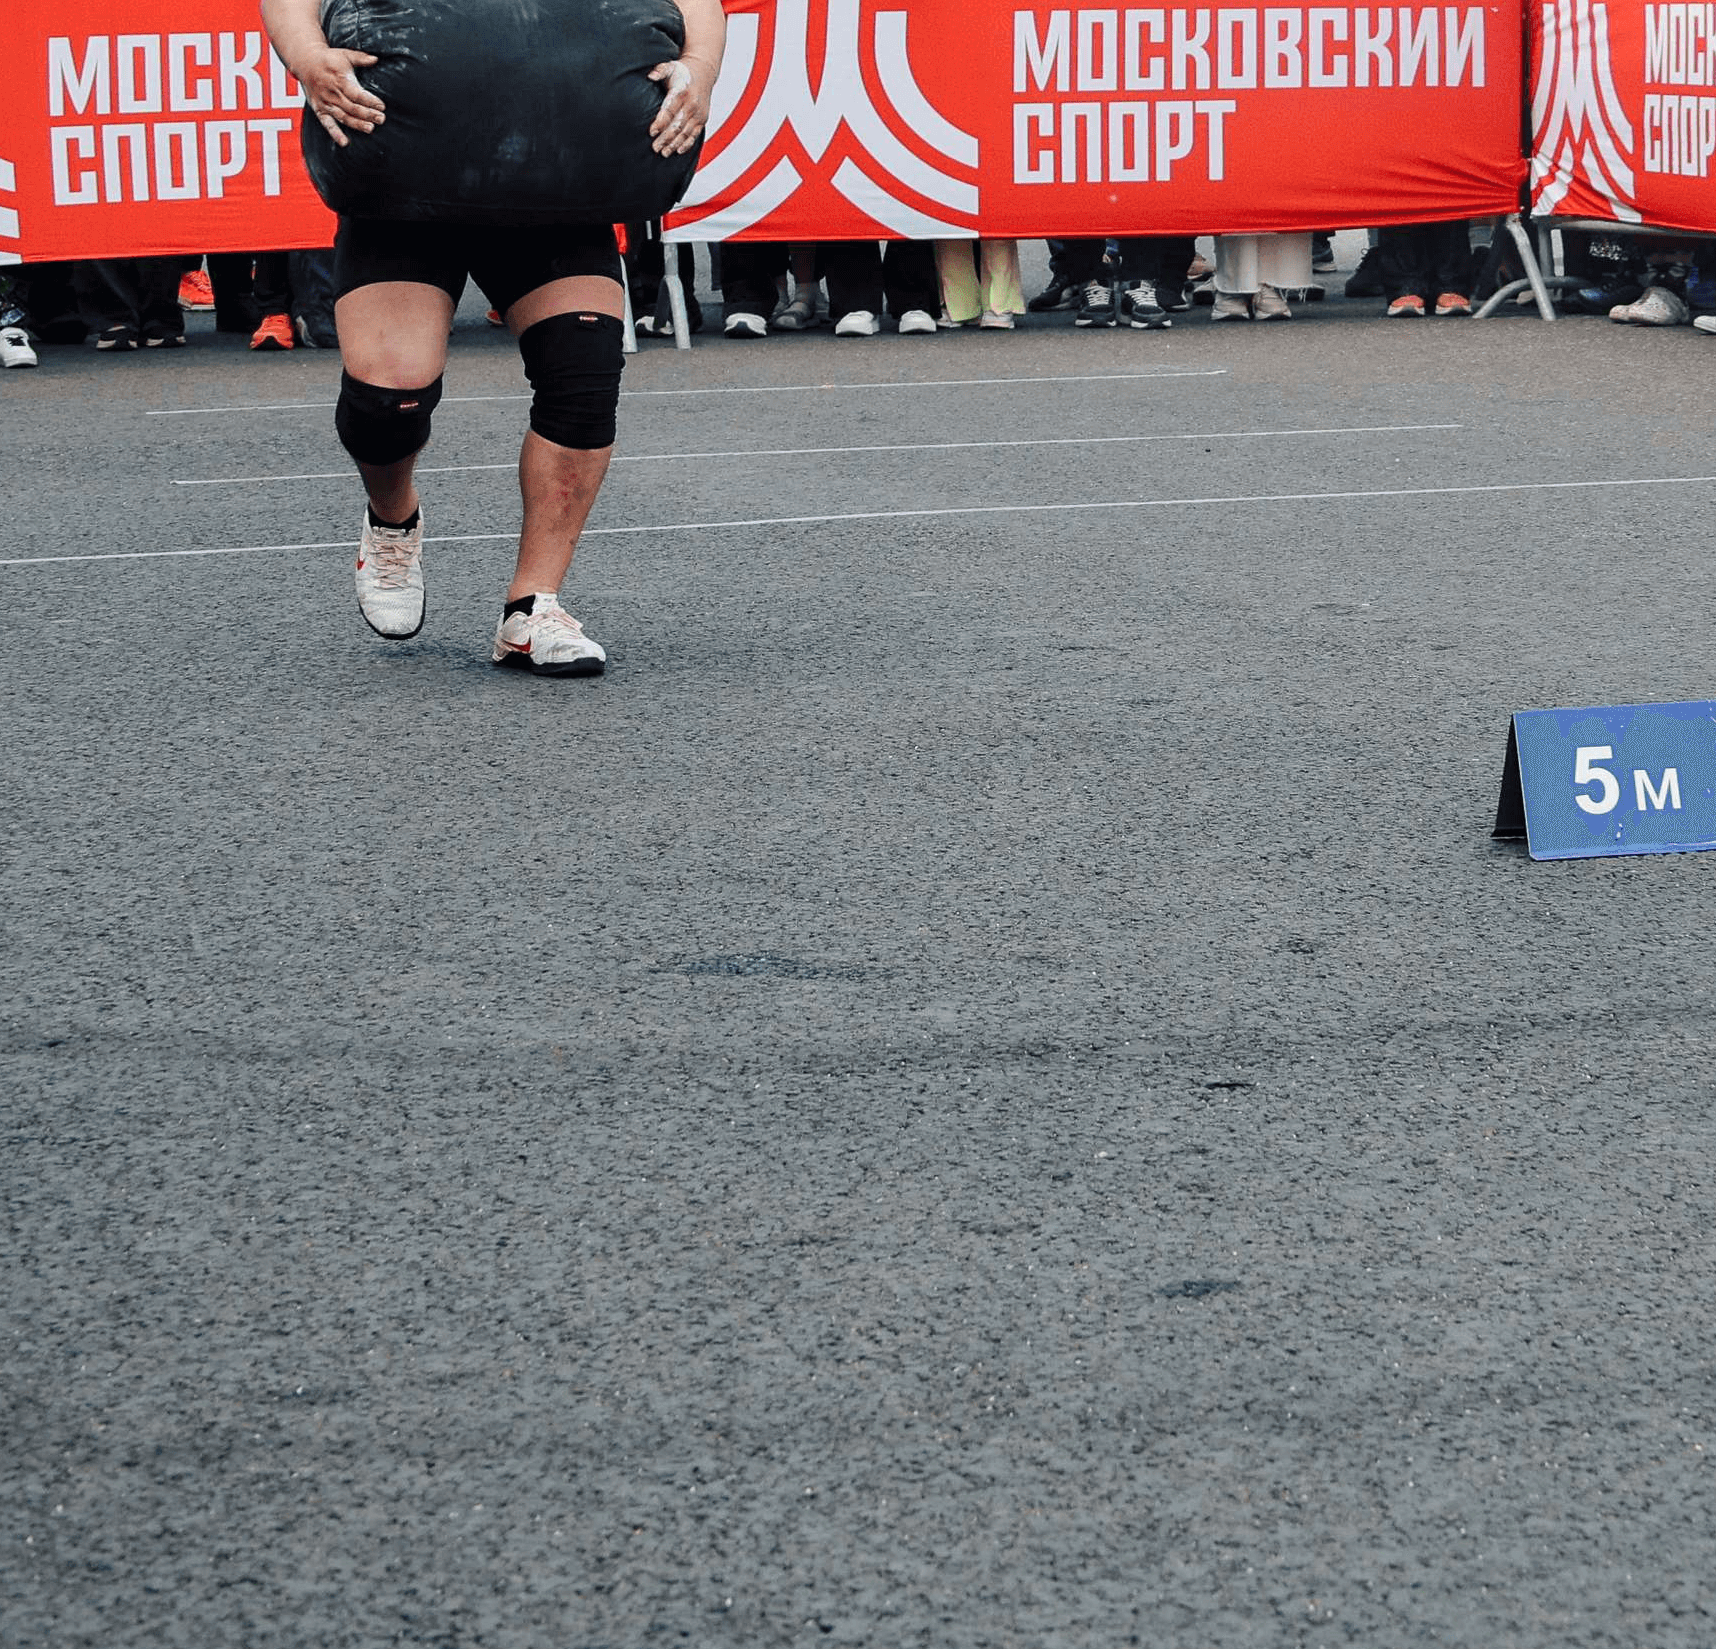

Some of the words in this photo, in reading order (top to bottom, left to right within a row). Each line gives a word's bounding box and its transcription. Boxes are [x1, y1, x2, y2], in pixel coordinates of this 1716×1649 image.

[50, 119, 292, 206] СПОРТ
[1013, 99, 1237, 184] СПОРТ
[1574, 744, 1620, 815] 5
